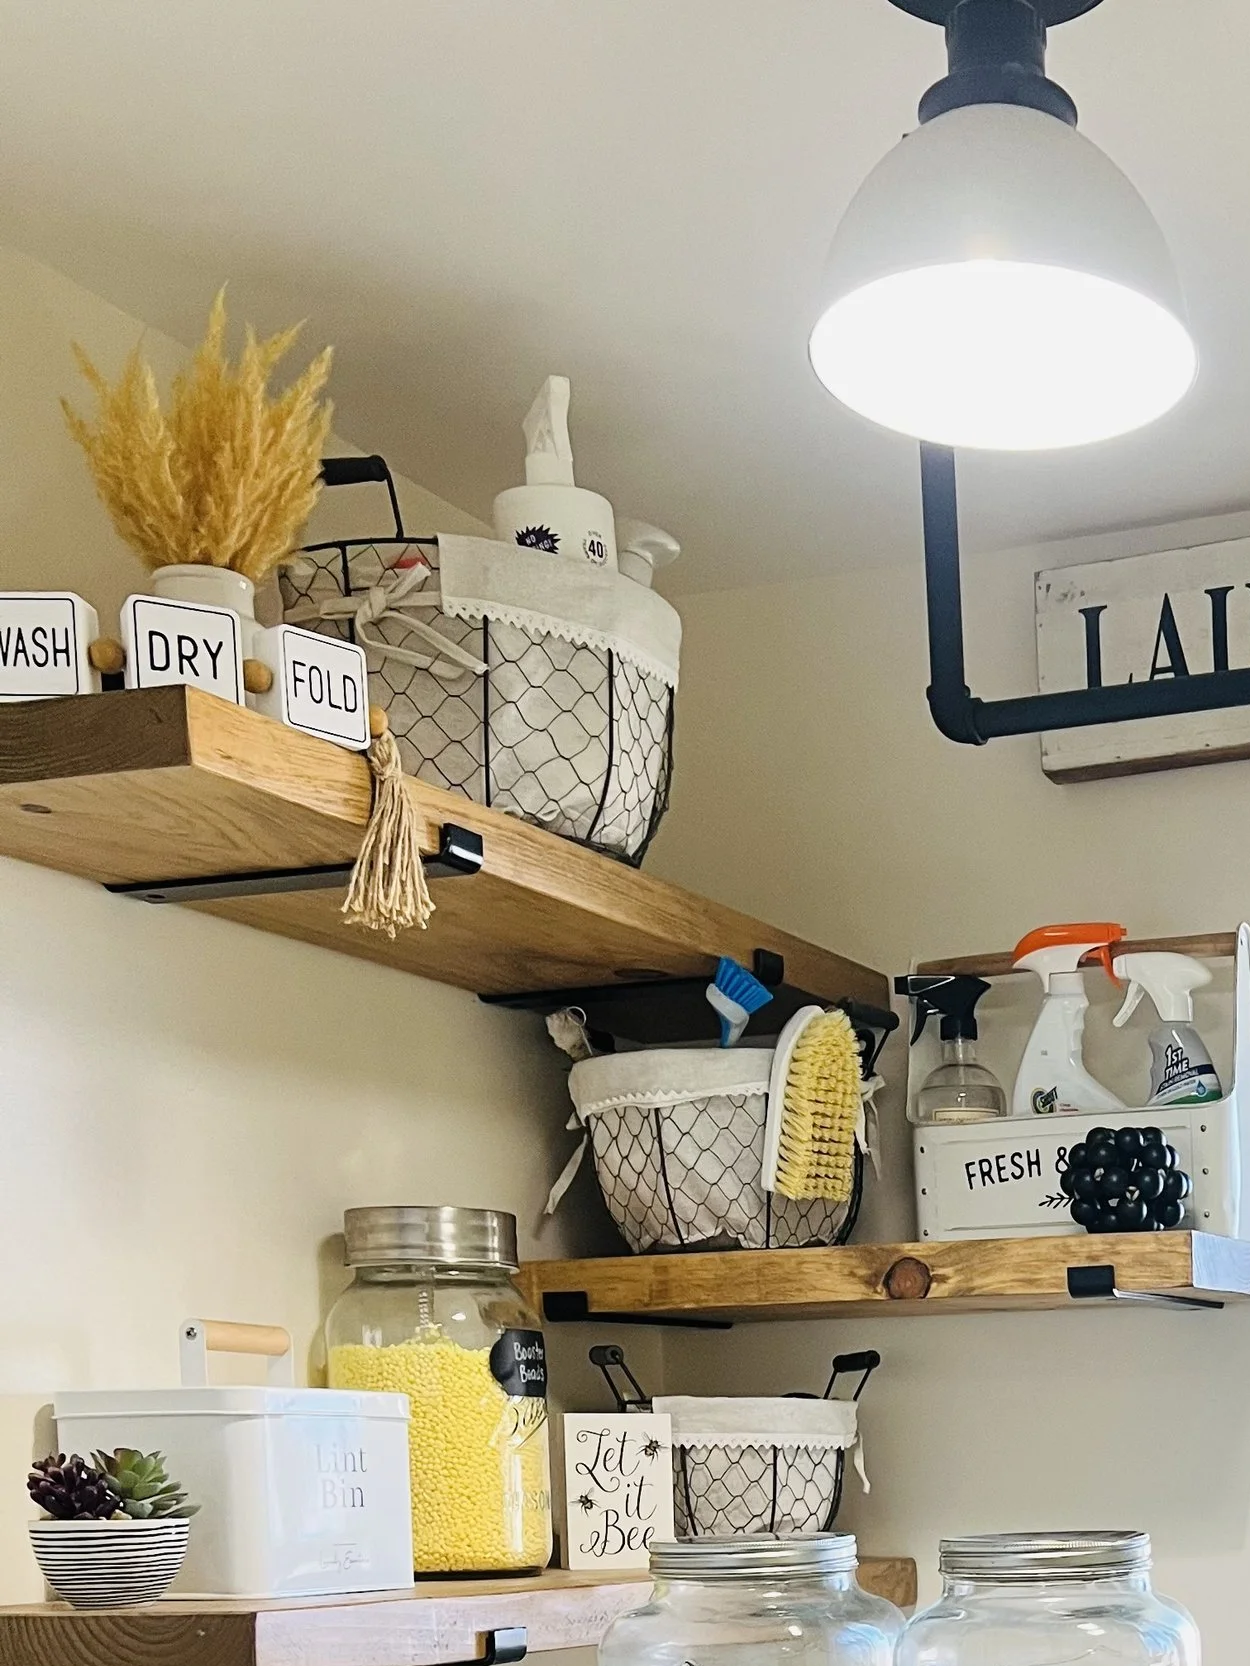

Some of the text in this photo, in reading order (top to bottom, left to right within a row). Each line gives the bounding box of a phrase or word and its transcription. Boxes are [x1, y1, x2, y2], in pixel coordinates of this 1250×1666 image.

[525, 534, 536, 546] NO
[588, 539, 604, 559] 40
[149, 630, 223, 680] DRY
[292, 660, 357, 713] FOLD
[1166, 1046, 1183, 1067] 1ST
[1166, 1058, 1189, 1081] TIME
[965, 1147, 1070, 1191] FRESH &
[513, 1341, 544, 1361] Booster
[520, 1364, 545, 1383] Beads
[316, 1442, 367, 1472] Lint
[576, 1428, 640, 1493] Let
[322, 1479, 365, 1509] Bin
[626, 1476, 657, 1520] it
[580, 1509, 655, 1557] Bee
